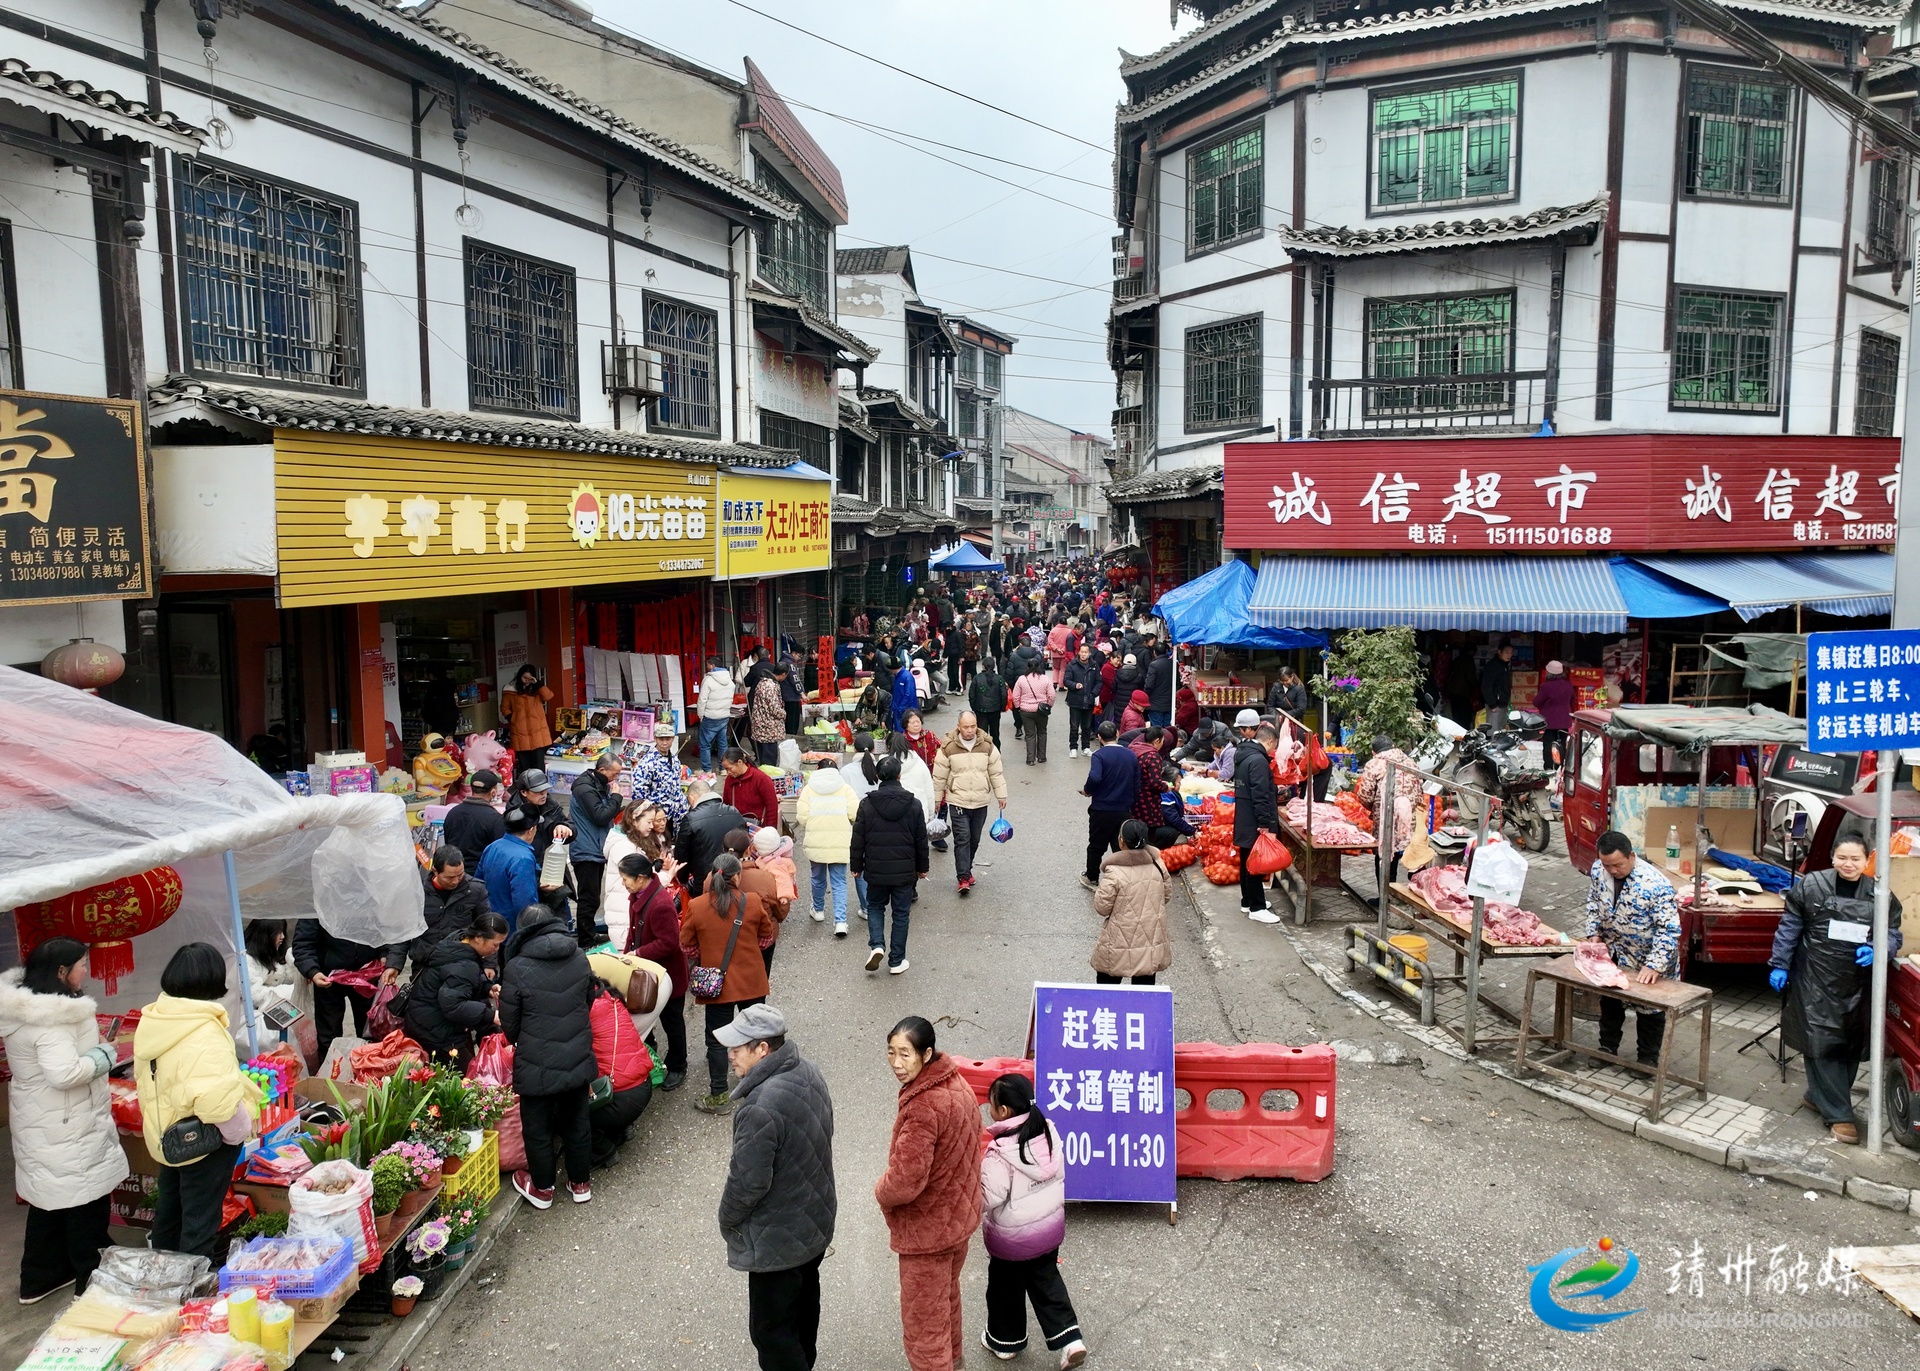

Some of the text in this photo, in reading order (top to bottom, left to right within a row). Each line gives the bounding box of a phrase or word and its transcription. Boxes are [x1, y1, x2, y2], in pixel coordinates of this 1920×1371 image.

[723, 500, 764, 522] 和成天下
[1267, 464, 1598, 525] 诚信超市
[608, 493, 707, 540] 阳光苗苗
[766, 499, 829, 541] 大王小王商行
[29, 527, 126, 549] 简便灵活
[1486, 526, 1612, 545] 15111501688
[10, 548, 131, 565] 电动车 黄金 家电 电脑
[1817, 711, 1920, 739] 货运车等机动车
[1061, 1006, 1146, 1051] 赶集日
[1046, 1068, 1164, 1114] 交通管制
